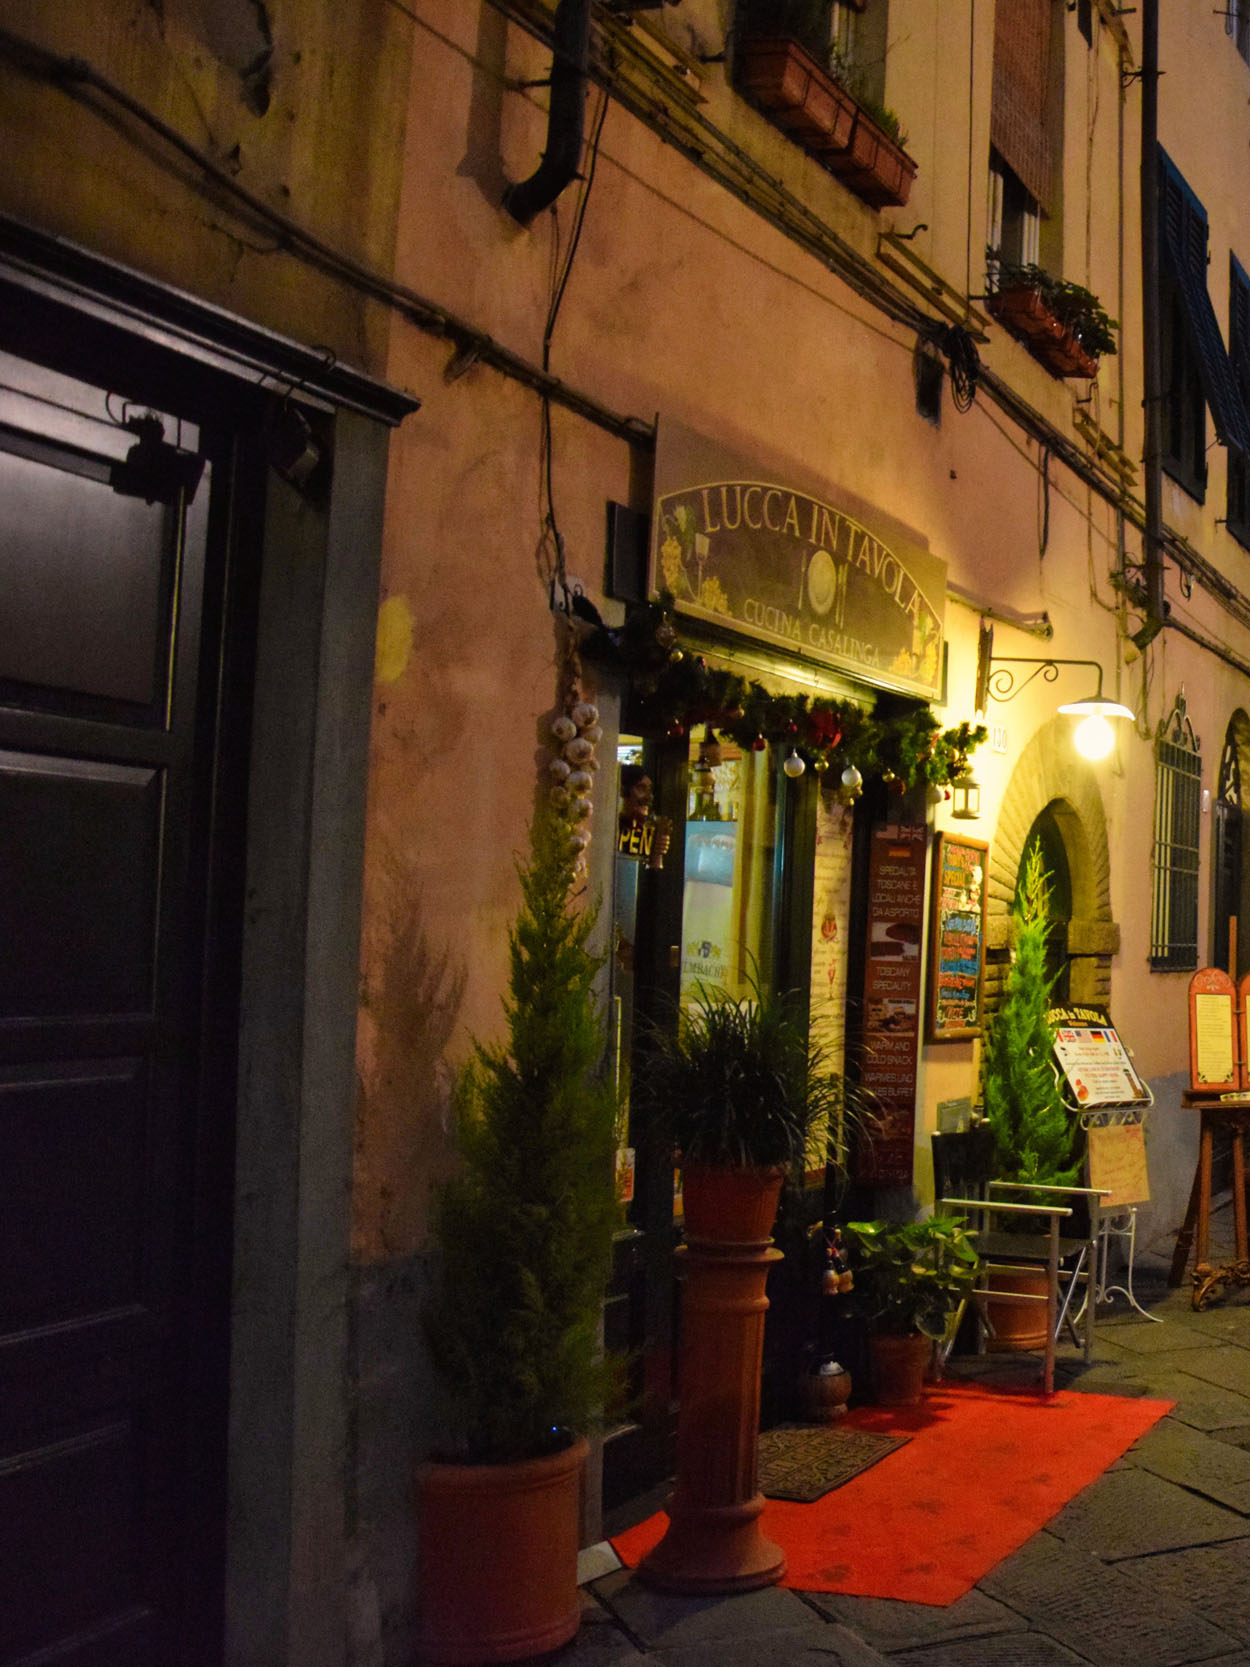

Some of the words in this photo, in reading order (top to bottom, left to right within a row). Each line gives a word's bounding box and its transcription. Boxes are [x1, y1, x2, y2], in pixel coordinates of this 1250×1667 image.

[702, 486, 801, 537] LUCCA
[808, 504, 841, 552] IN
[845, 521, 922, 616] TAVOLA
[743, 599, 802, 640] CUCINA
[808, 624, 881, 667] CASALINGA
[618, 823, 655, 856] PEN
[884, 907, 920, 918] ASPORTO
[876, 966, 911, 977] TOSCANY
[1073, 1007, 1108, 1026] TAVOLA
[870, 1041, 894, 1051] WARM
[895, 1042, 910, 1052] AND
[866, 1054, 886, 1065] COLD
[887, 1055, 913, 1065] SNACK
[864, 1072, 896, 1082] WARMES
[897, 1073, 913, 1083] UND
[888, 1087, 914, 1097] BUFFET
